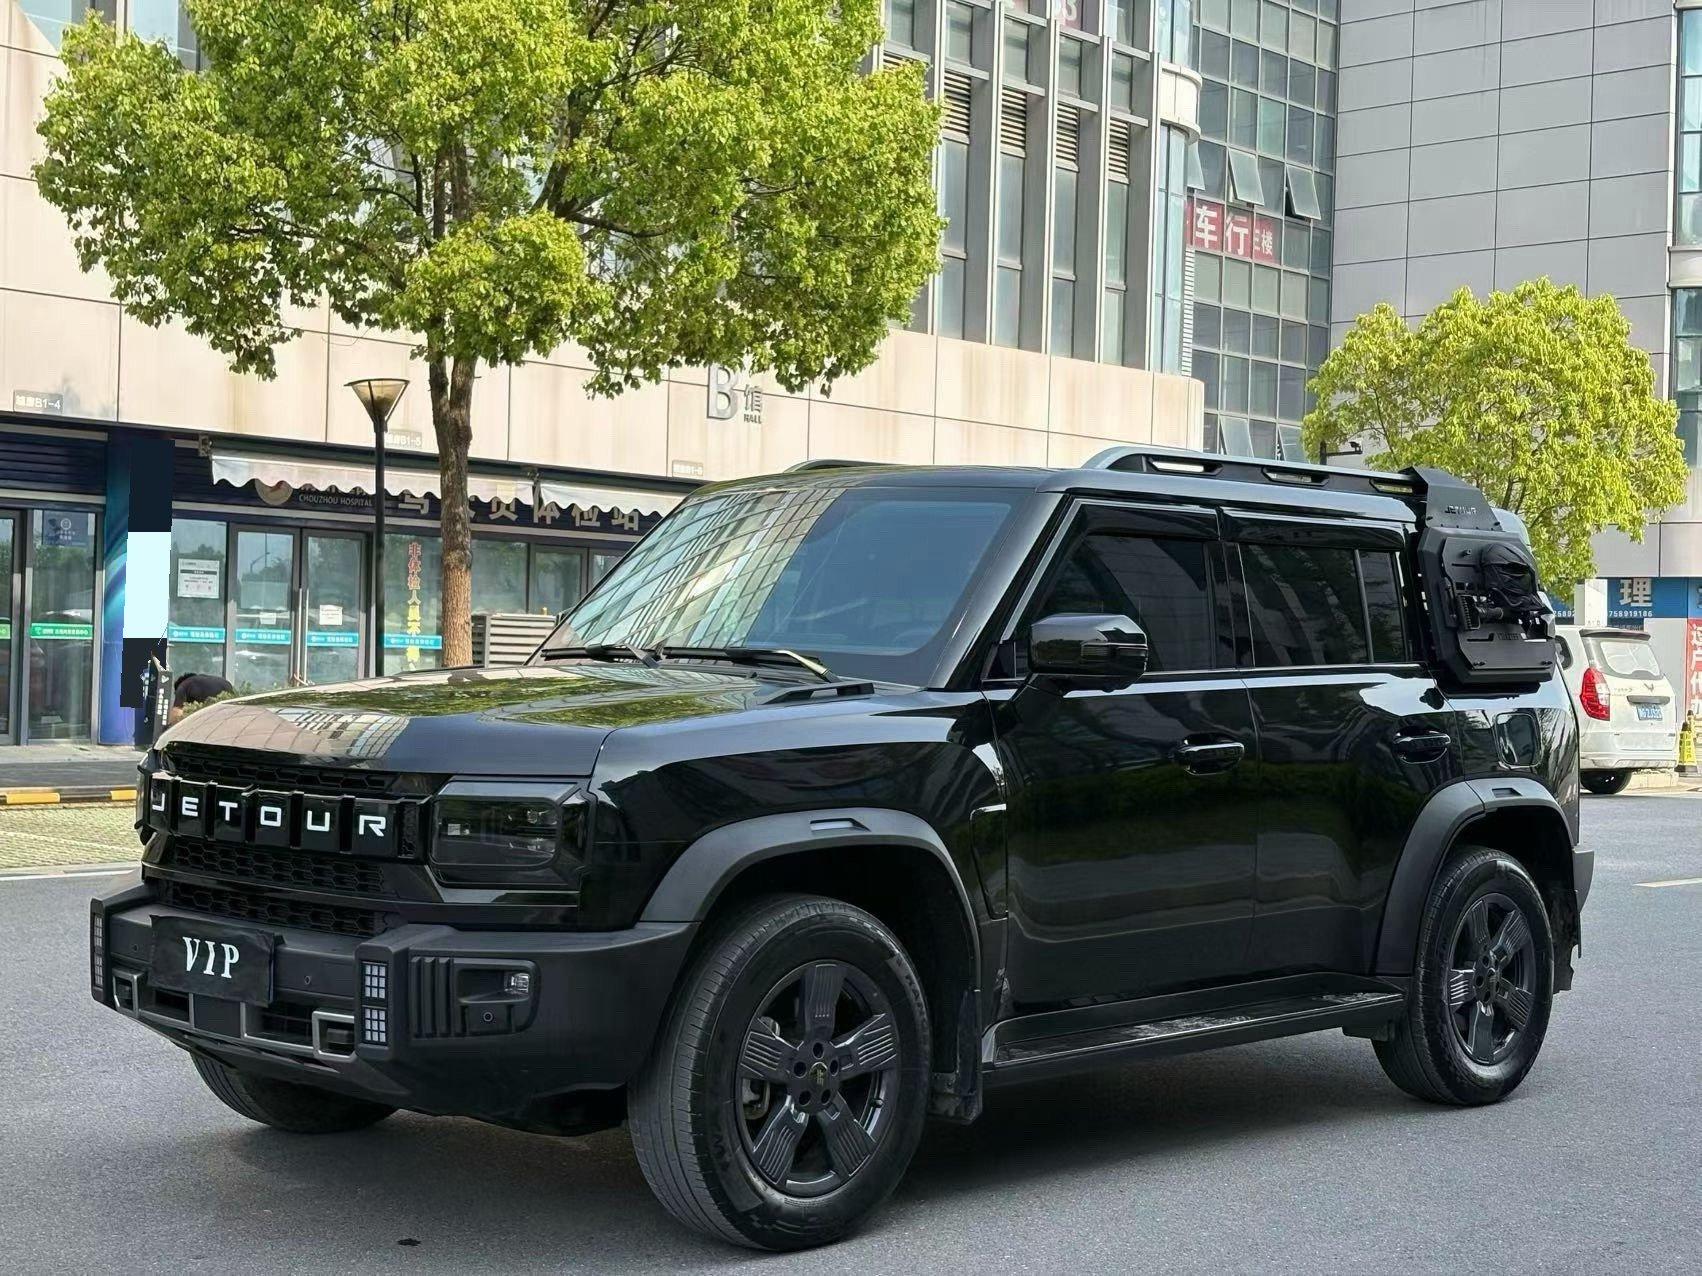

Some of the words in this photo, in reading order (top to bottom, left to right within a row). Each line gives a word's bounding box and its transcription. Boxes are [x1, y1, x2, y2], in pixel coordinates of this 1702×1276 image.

[1195, 205, 1249, 256] 车行
[16, 395, 61, 410] B1-4
[707, 360, 738, 421] B
[744, 384, 762, 412] 馆
[299, 494, 338, 505] CHOUZHOU
[340, 497, 373, 507] HOSPITAL
[1619, 577, 1653, 607] 理
[152, 792, 387, 838] JETOUR
[182, 936, 241, 980] VIP
